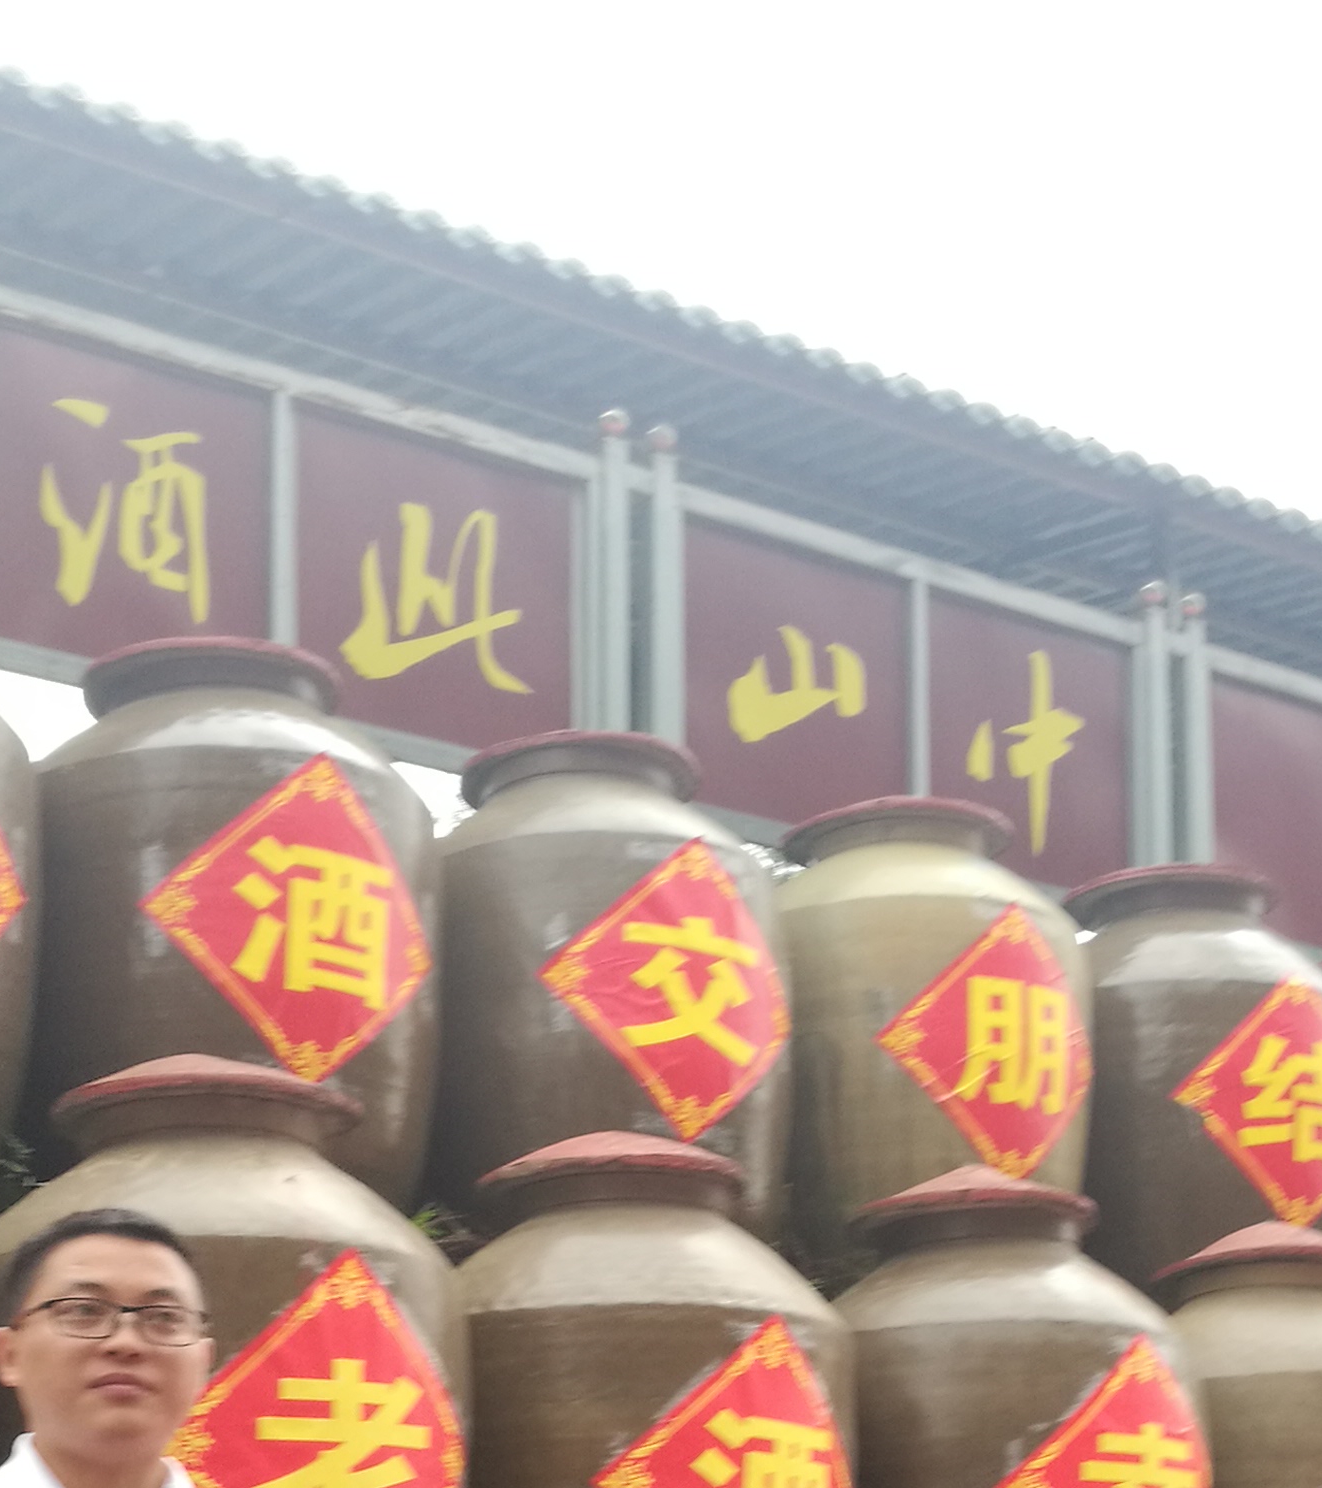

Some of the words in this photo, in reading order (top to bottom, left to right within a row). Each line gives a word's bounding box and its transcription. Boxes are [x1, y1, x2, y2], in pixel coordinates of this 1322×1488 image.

[39, 397, 208, 624] 酒
[339, 503, 533, 694] 此
[726, 625, 866, 743] 山
[232, 834, 394, 1011] 酒
[621, 916, 760, 1067] 交
[955, 976, 1069, 1117] 朋
